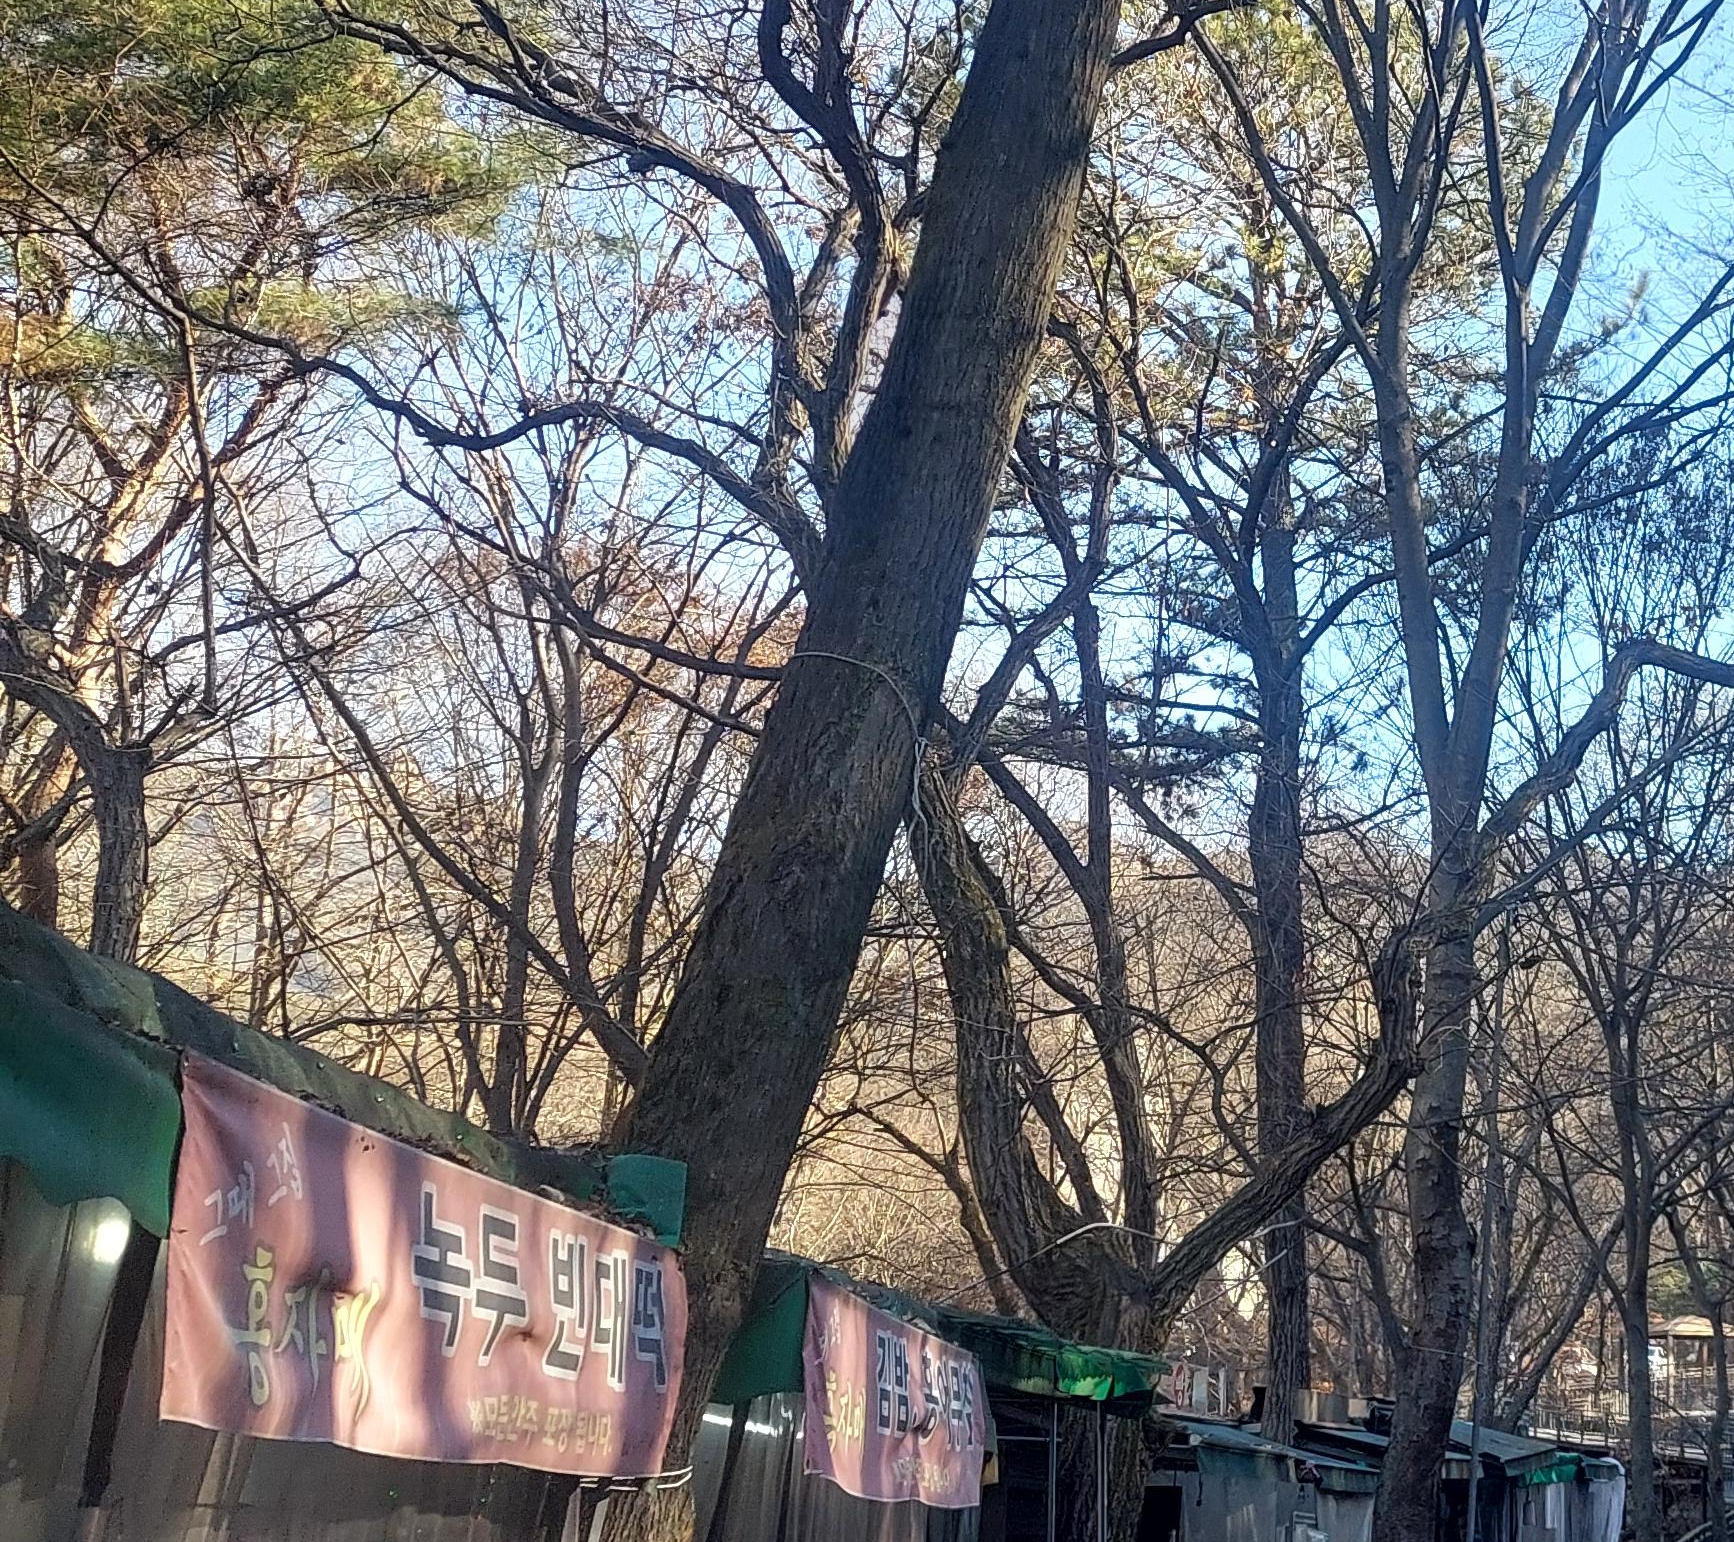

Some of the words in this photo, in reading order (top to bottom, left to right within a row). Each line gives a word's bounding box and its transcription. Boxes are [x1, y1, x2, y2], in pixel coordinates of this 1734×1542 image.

[200, 1160, 254, 1246] 그때
[267, 1121, 302, 1208] 그집
[230, 1246, 381, 1422] 홍자매
[411, 1180, 530, 1367] 녹두
[542, 1227, 668, 1394] 빈대떡
[542, 1407, 571, 1454] 포장
